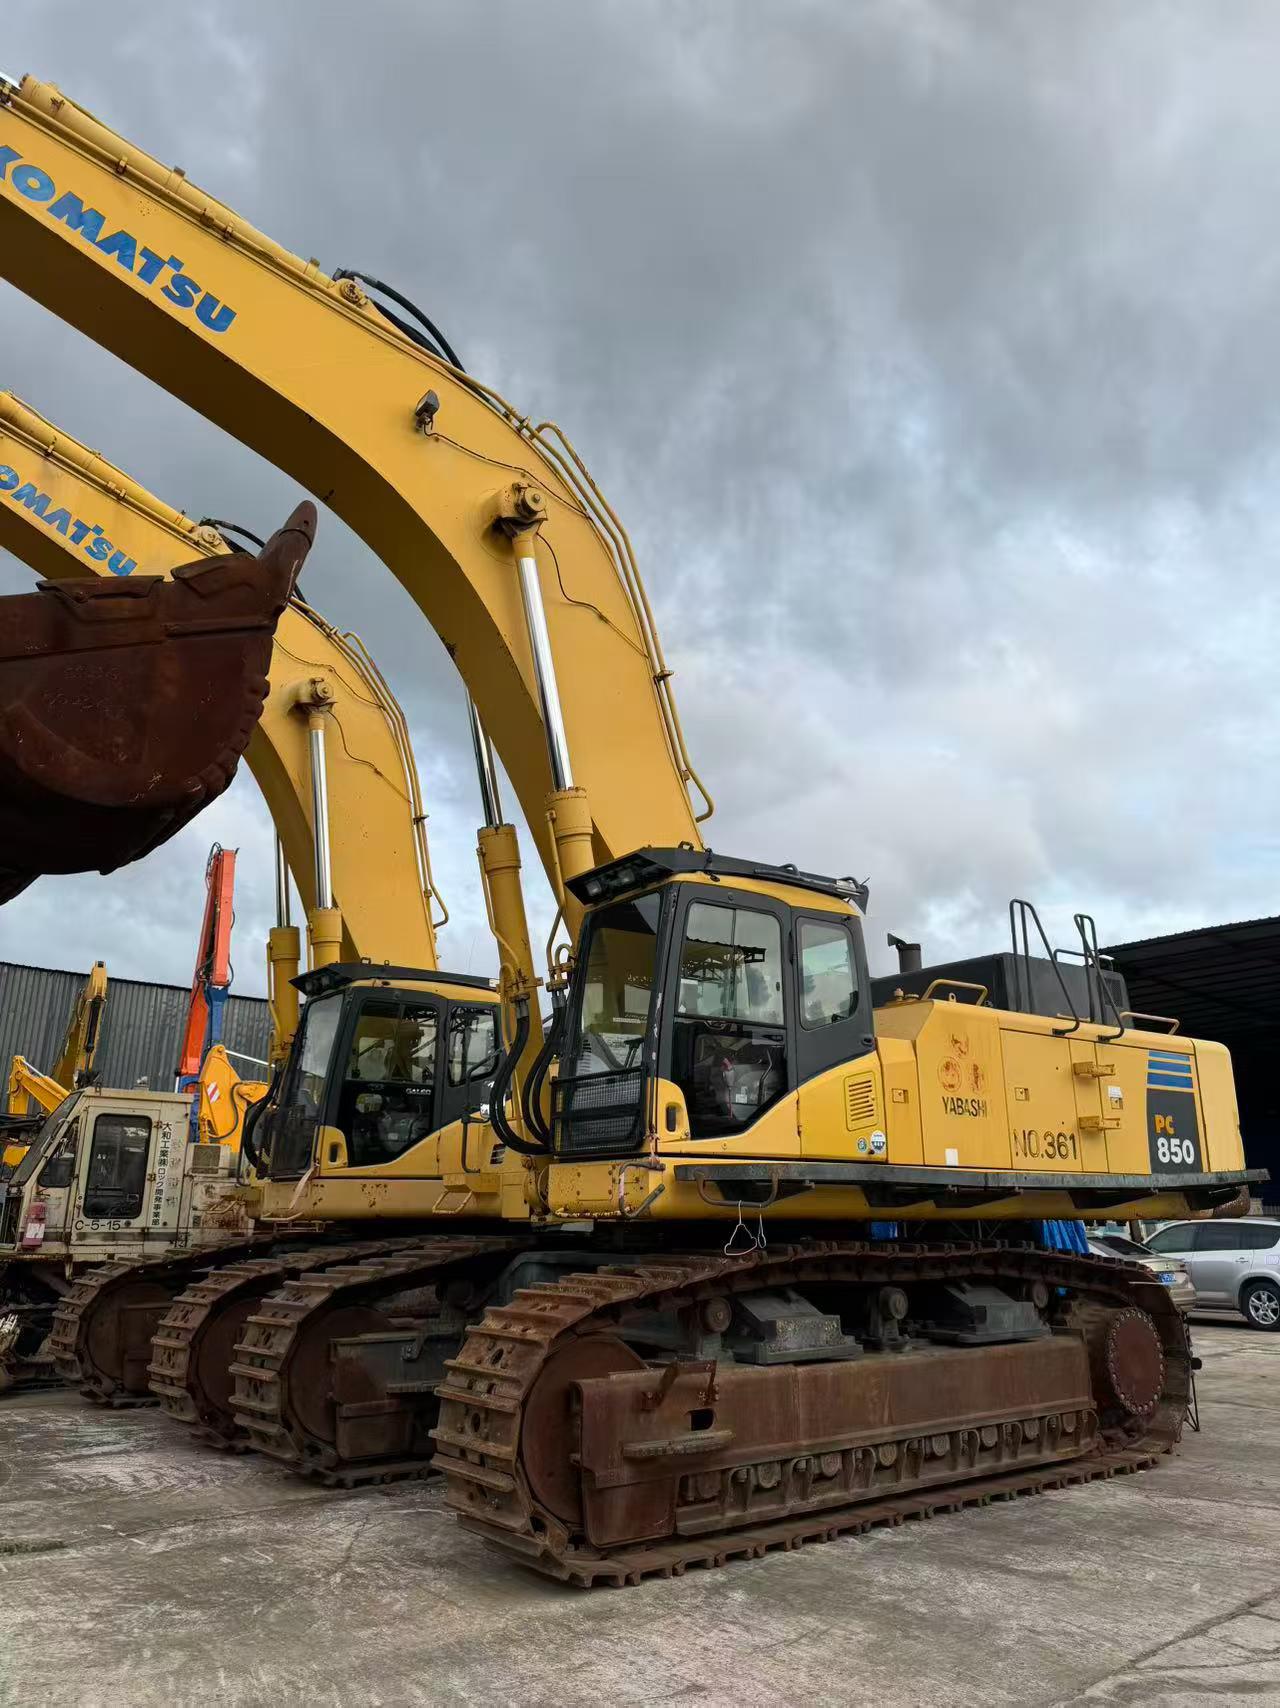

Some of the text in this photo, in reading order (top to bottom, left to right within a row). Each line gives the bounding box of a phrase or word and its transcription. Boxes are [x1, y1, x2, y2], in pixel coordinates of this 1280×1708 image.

[941, 1096, 987, 1118] YABASHI
[1154, 1113, 1175, 1135] PC
[1157, 1137, 1195, 1165] 850
[74, 1219, 121, 1231] C-5-15
